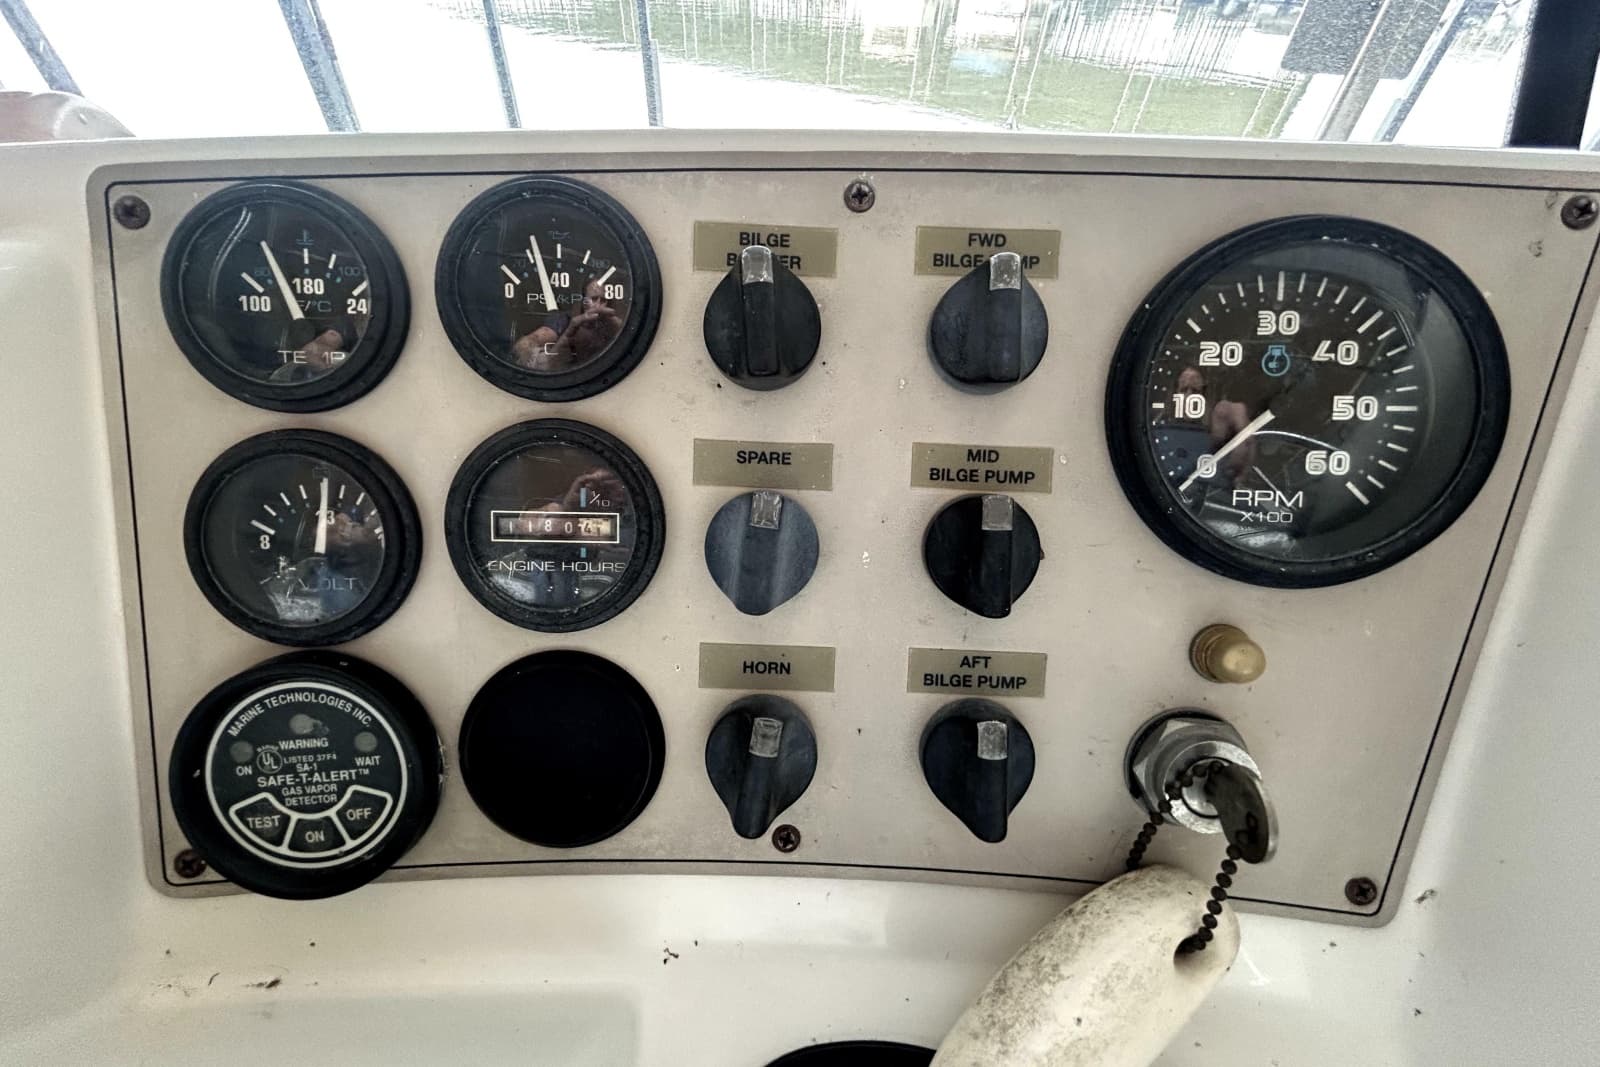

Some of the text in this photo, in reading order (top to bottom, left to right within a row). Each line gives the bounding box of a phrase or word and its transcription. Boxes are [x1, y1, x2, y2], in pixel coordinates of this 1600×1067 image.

[739, 232, 791, 248] BILGE
[968, 233, 1007, 248] FWD
[726, 253, 801, 270] BER
[933, 253, 984, 268] BILGE
[292, 278, 324, 295] 180
[550, 272, 570, 288] 40
[504, 284, 514, 299] 0
[604, 284, 624, 300] 80
[238, 296, 272, 312] 100
[1256, 310, 1301, 336] 30
[278, 350, 346, 364] TEP
[1199, 341, 1243, 366] 20
[1312, 340, 1359, 365] 40
[1172, 393, 1206, 419] 10
[1331, 395, 1379, 421] 50
[736, 450, 792, 465] SPARE
[966, 449, 1000, 463] MID
[1305, 450, 1350, 476] 60
[1196, 453, 1218, 478] 0
[929, 467, 1036, 485] BILGE PUMP
[1231, 489, 1304, 508] RPM
[1239, 511, 1293, 523] X100
[259, 534, 271, 550] 8
[487, 560, 626, 573] ENGINE HOURS
[742, 661, 792, 675] HORN
[959, 656, 992, 669] AFT
[923, 673, 1028, 690] BILGE PUMP
[227, 692, 372, 737] MARINE TECHNOLOGIES INC.
[278, 737, 329, 750] WARNING
[283, 754, 315, 764] LISTED
[354, 755, 381, 767] WAIT
[235, 765, 253, 777] ON
[296, 763, 318, 773] SA-1
[281, 783, 338, 797] GAS VAPOR
[285, 794, 338, 807] DETECTOR
[346, 807, 372, 821] OFF
[247, 815, 281, 829] TEST
[305, 831, 325, 843] ON
